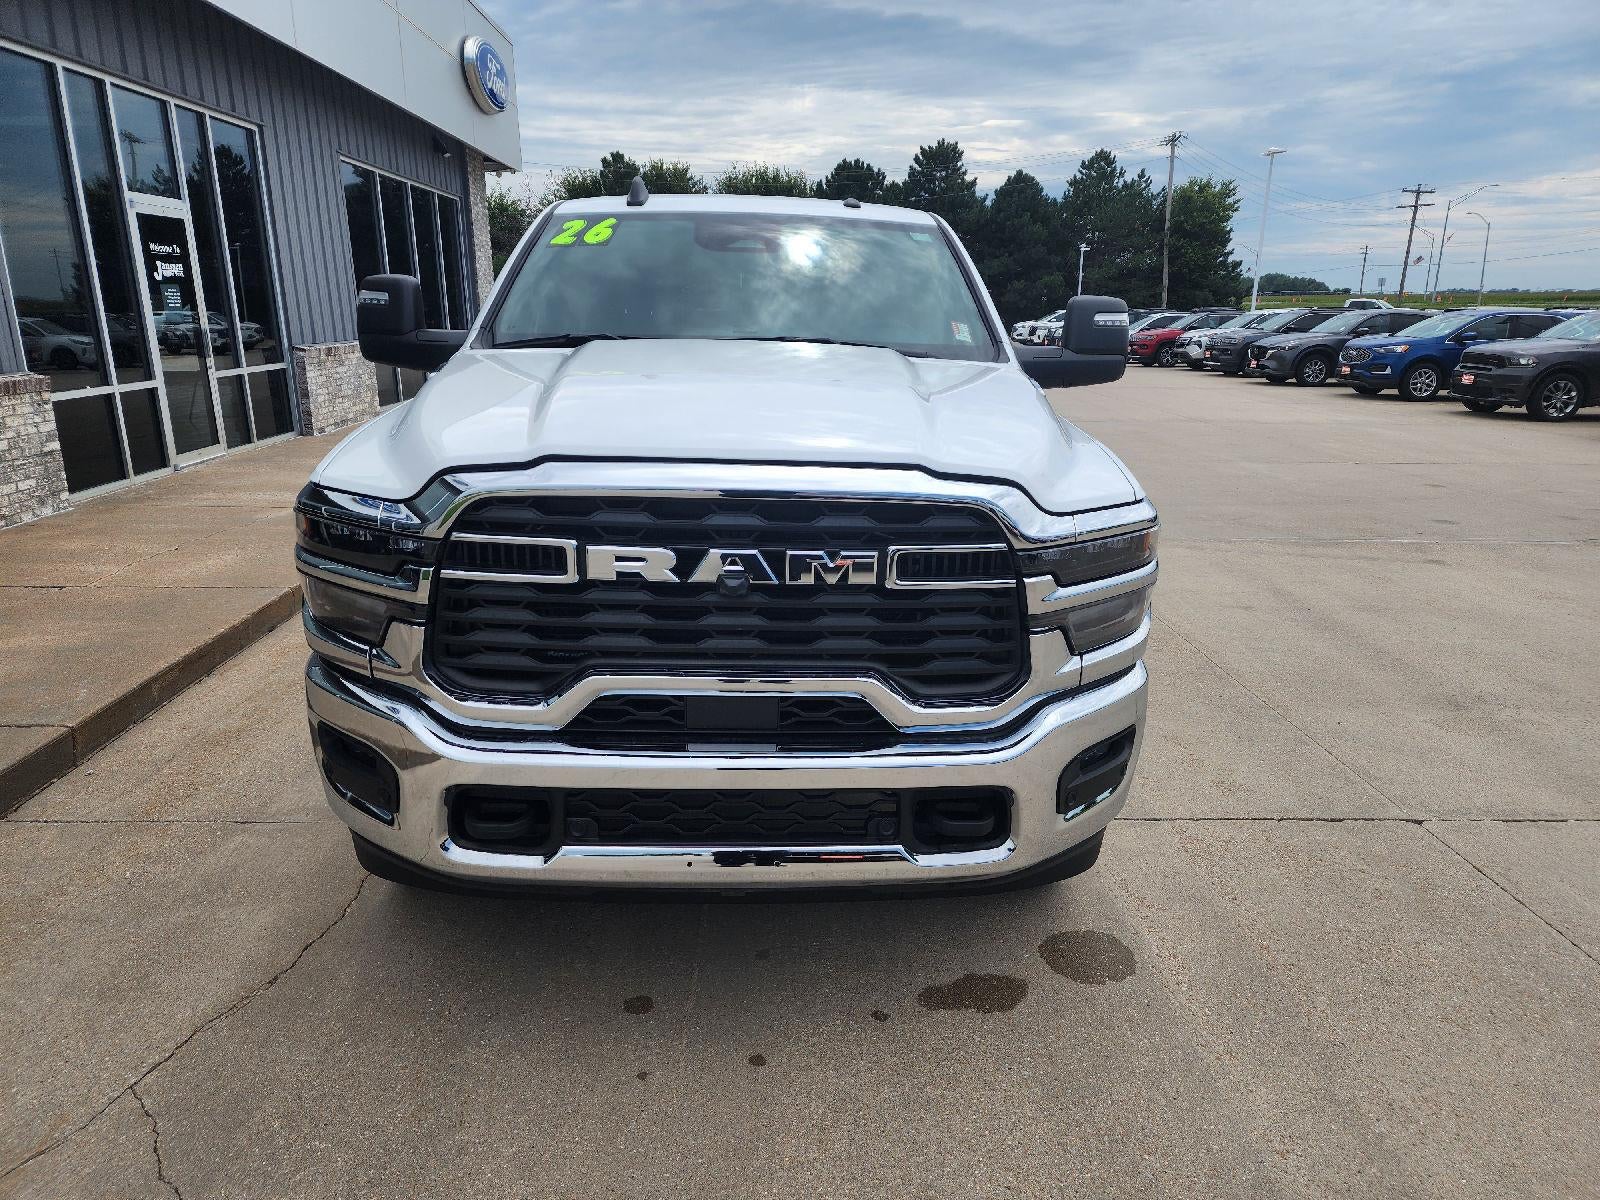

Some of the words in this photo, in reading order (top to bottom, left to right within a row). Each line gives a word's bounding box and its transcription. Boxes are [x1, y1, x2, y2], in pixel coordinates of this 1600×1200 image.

[486, 53, 506, 100] Ford
[148, 241, 172, 253] Welcome
[549, 217, 618, 246] 26
[585, 545, 879, 585] RAM
